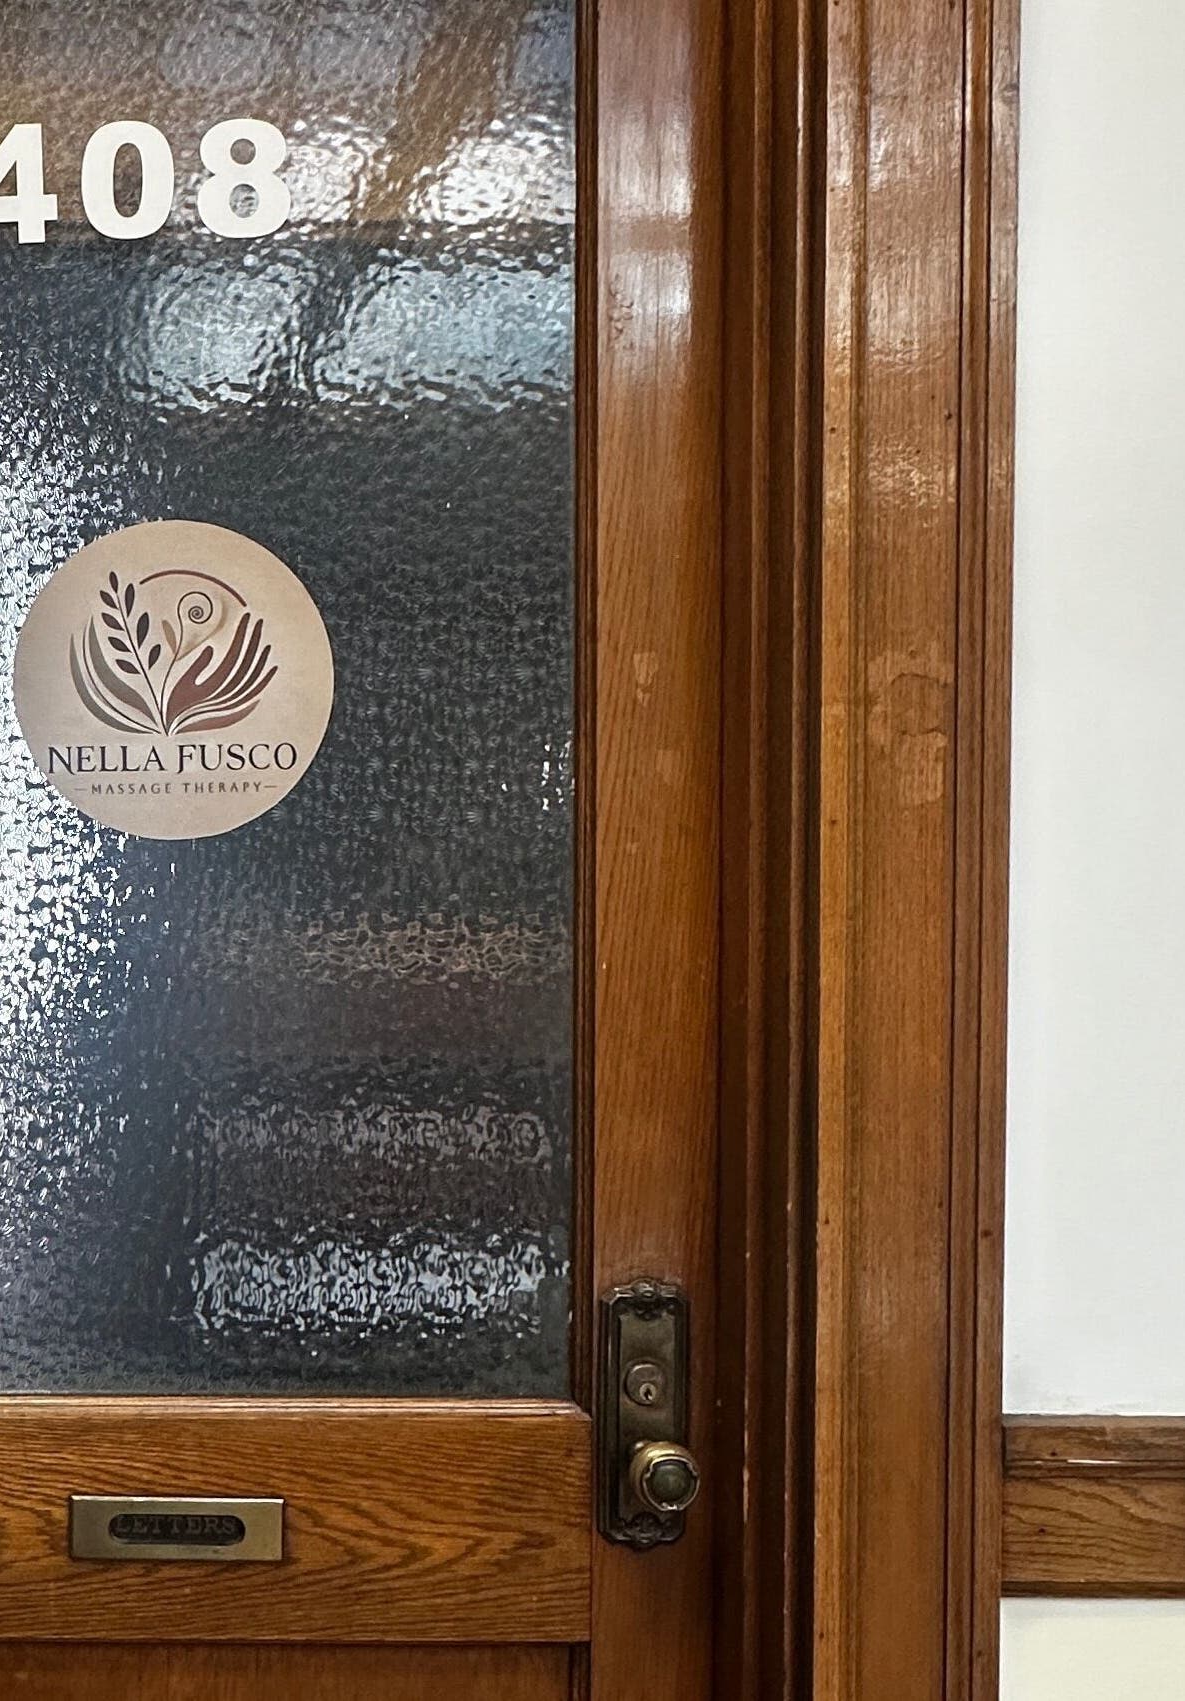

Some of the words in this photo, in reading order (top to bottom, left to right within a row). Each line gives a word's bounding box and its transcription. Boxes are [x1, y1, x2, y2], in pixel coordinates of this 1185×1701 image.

[48, 745, 166, 775] NELLA
[177, 742, 297, 774] FUSCO
[91, 782, 173, 795] MASSAGE
[182, 780, 263, 794] THERAPY
[115, 1515, 236, 1535] LETTERS
